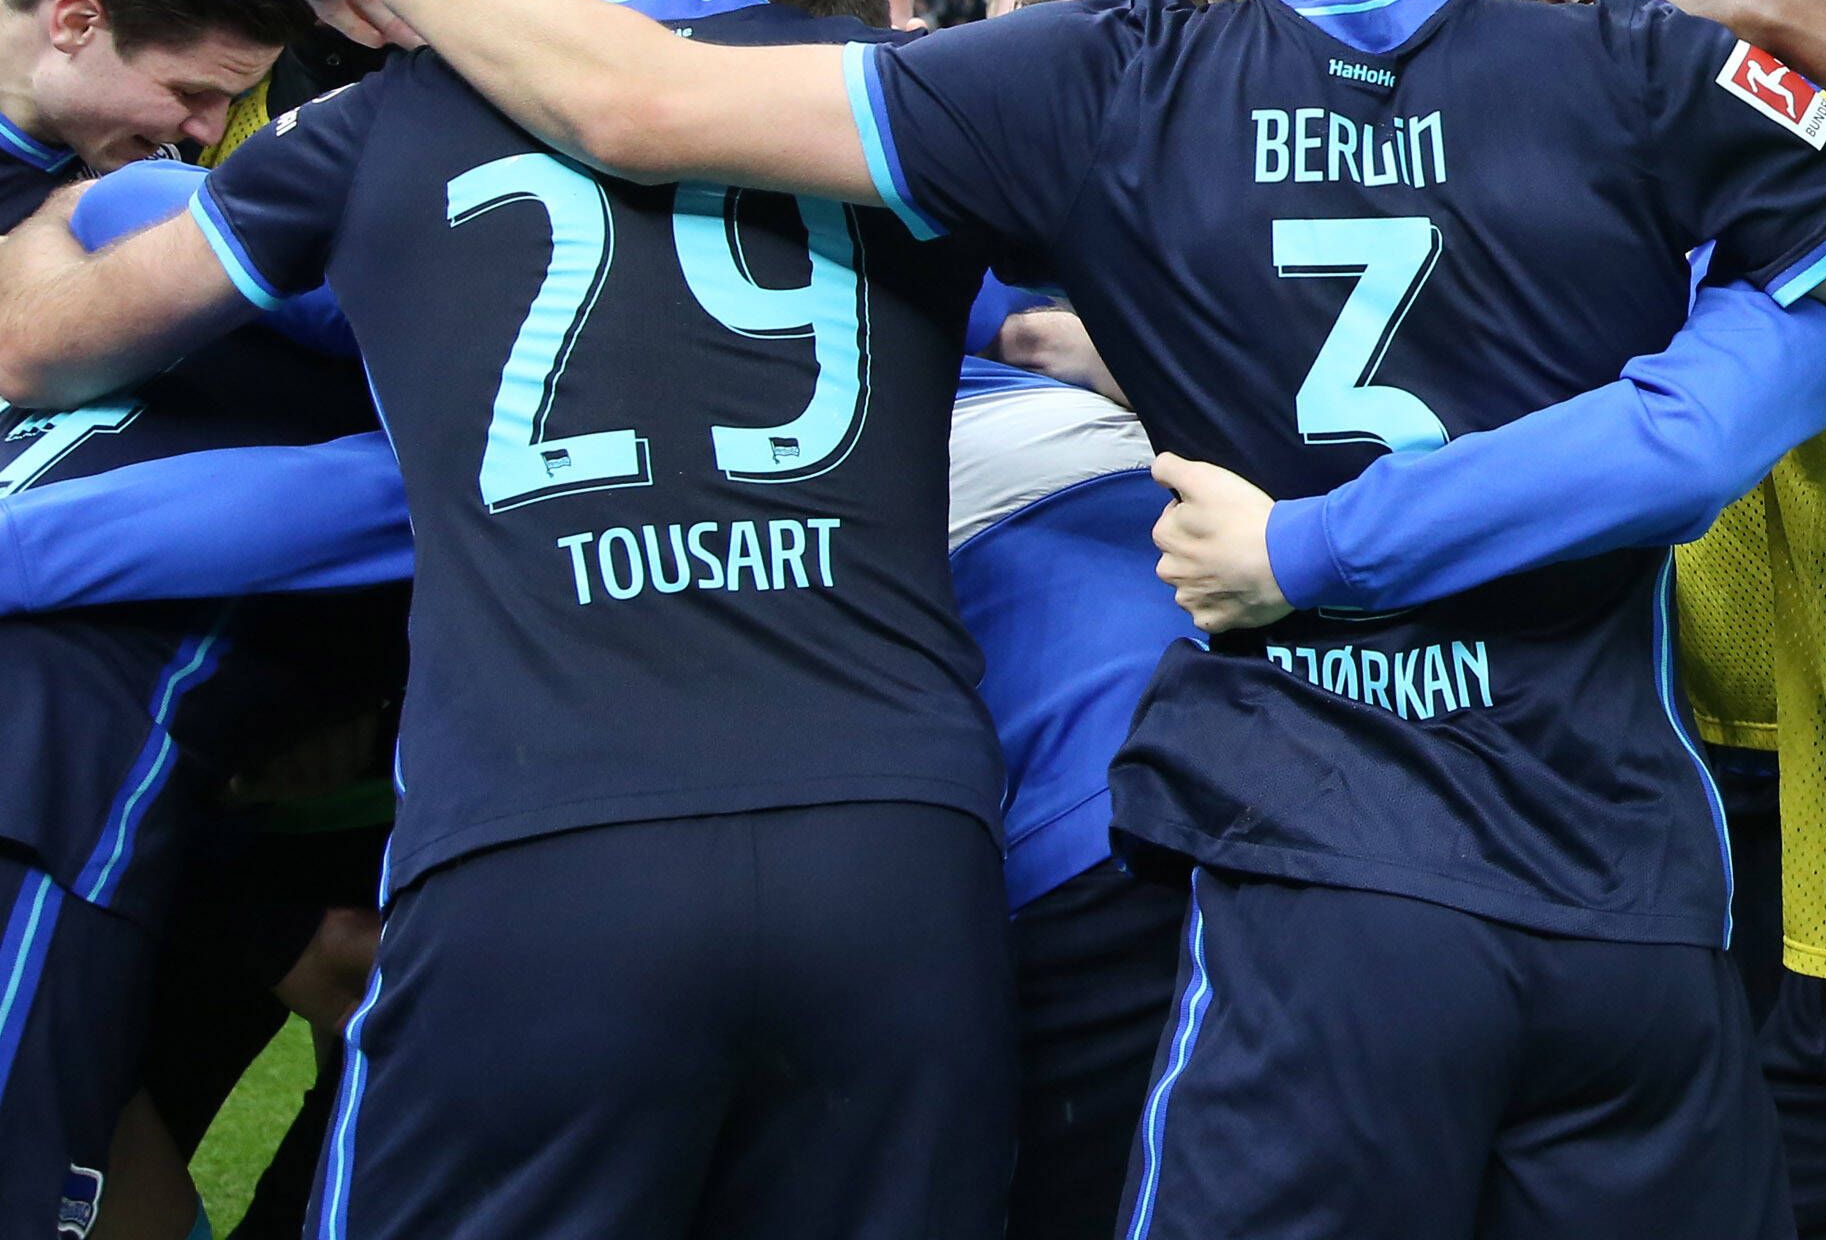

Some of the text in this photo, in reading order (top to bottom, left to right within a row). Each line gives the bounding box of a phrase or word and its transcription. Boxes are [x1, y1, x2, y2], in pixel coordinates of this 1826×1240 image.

[447, 152, 871, 515] 29
[1272, 216, 1450, 454] 3
[557, 517, 841, 606] TOUSART
